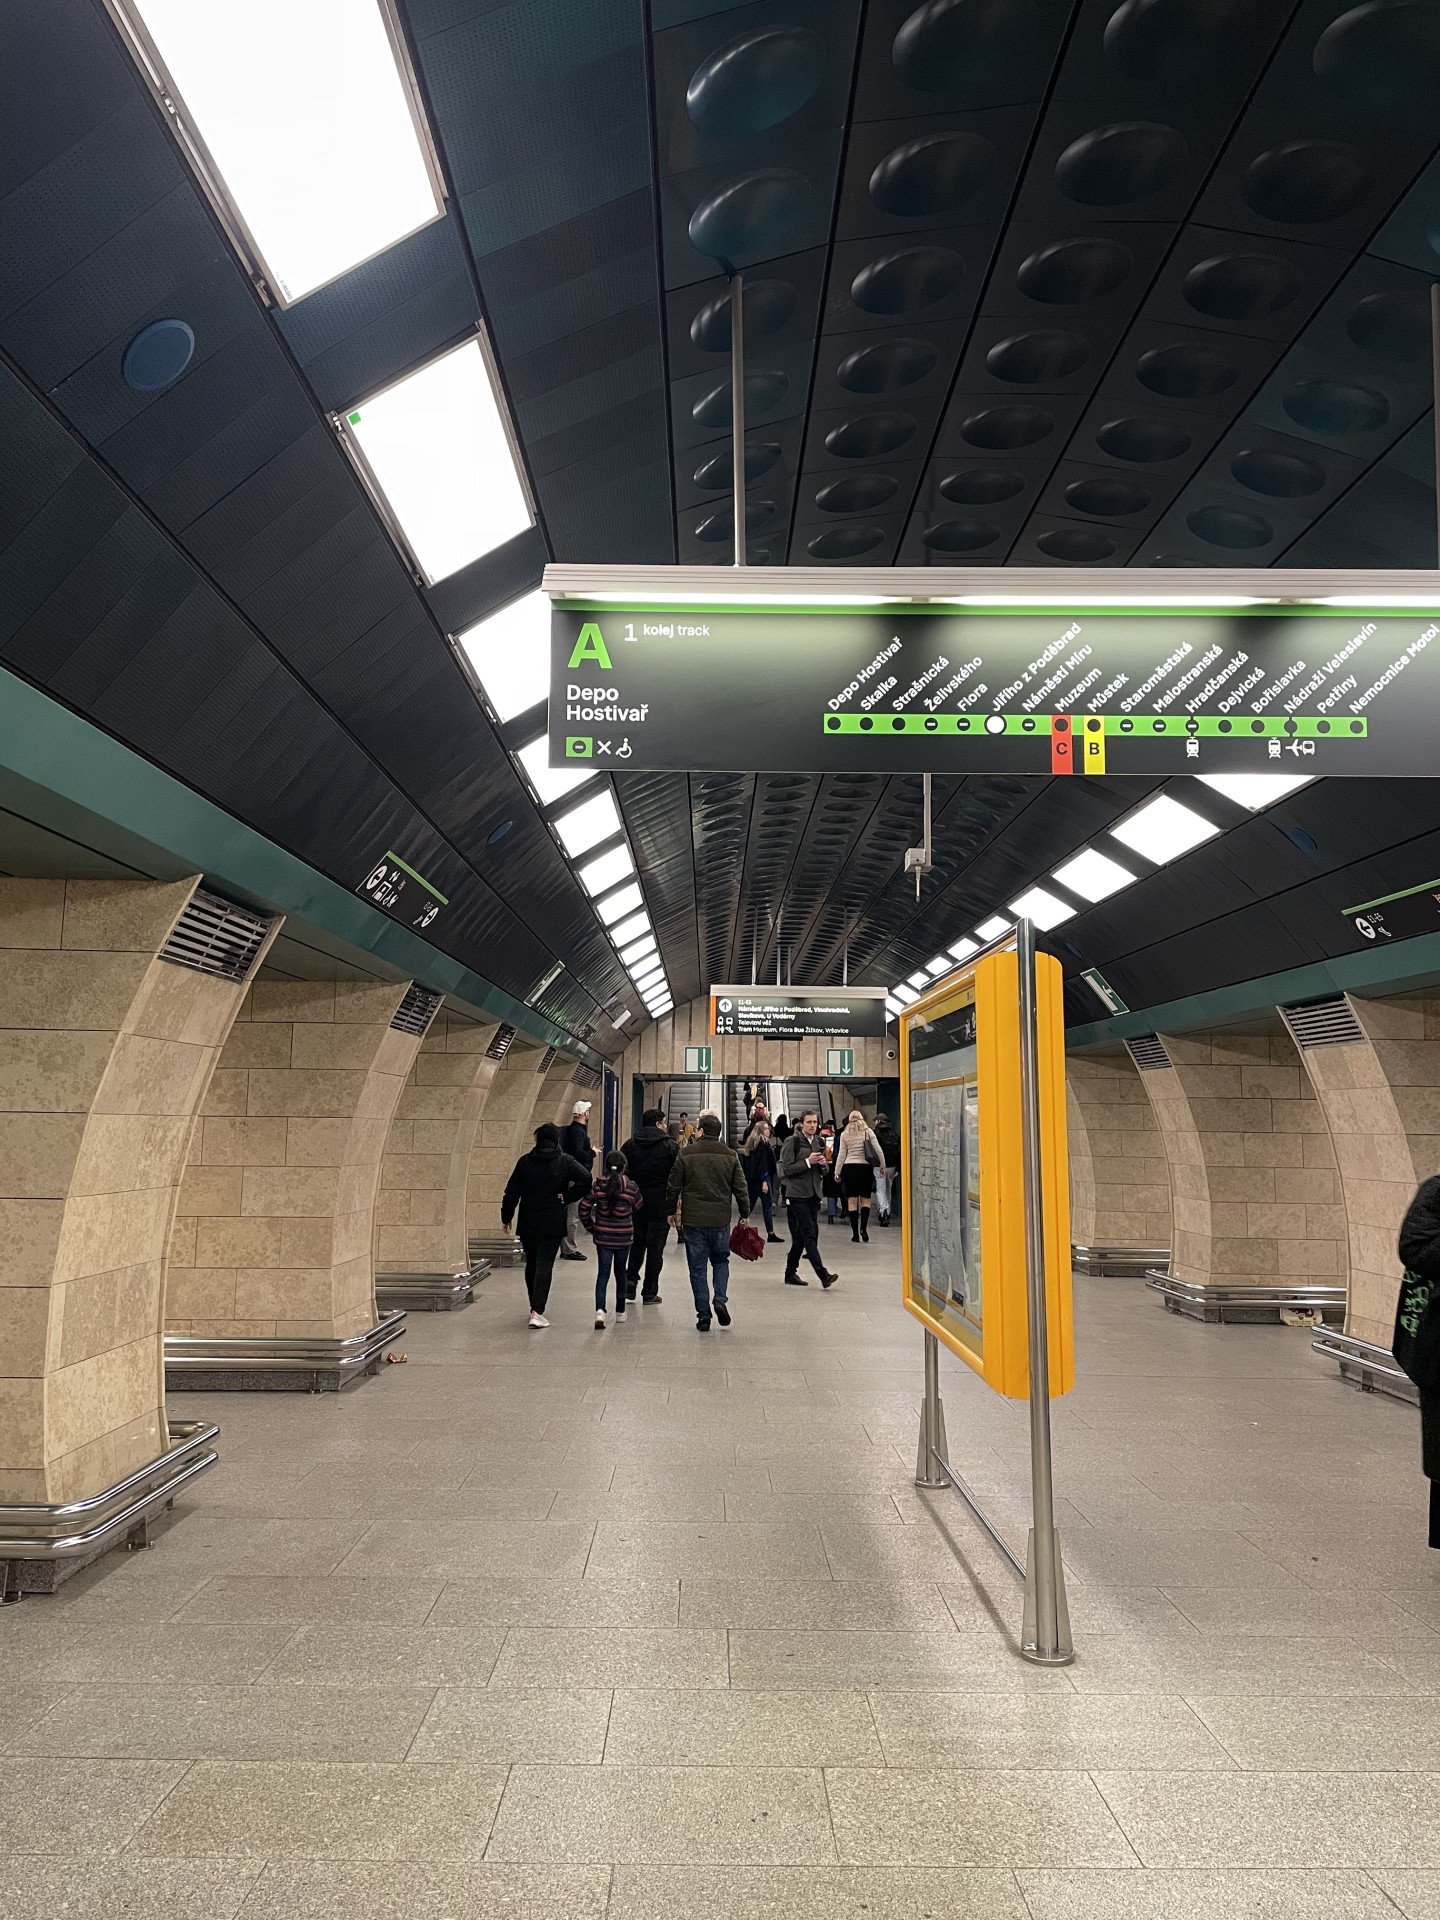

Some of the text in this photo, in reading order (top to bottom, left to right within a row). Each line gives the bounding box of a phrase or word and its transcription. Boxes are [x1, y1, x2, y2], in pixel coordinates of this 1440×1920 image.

[567, 622, 613, 669] A
[624, 623, 710, 642] 1 kolej track
[827, 635, 904, 712] Depo Hostivař
[892, 655, 951, 712] Strašnická
[924, 655, 984, 713] Želivského
[991, 621, 1082, 713] Jiřího z Poděbrad
[1021, 643, 1093, 713] Náměstí Míru
[1053, 665, 1103, 713] Muzeum
[1120, 640, 1195, 714] Staroměstská
[1152, 642, 1225, 714] Malostranská
[1184, 649, 1250, 714] Hradčanská
[1217, 666, 1266, 714] Dejvická
[1250, 659, 1308, 715] Bořislavka
[1283, 622, 1378, 715] Nádraží Veleslavín
[1348, 623, 1440, 715] Nemocnice Motol
[566, 684, 619, 704] Depo
[566, 703, 649, 722] Hostivař
[860, 674, 899, 712] Skalka
[956, 682, 989, 713] Flora
[1086, 671, 1130, 713] Můstek
[1316, 674, 1359, 715] Petřiny
[1056, 741, 1068, 755] C
[1089, 742, 1100, 755] B
